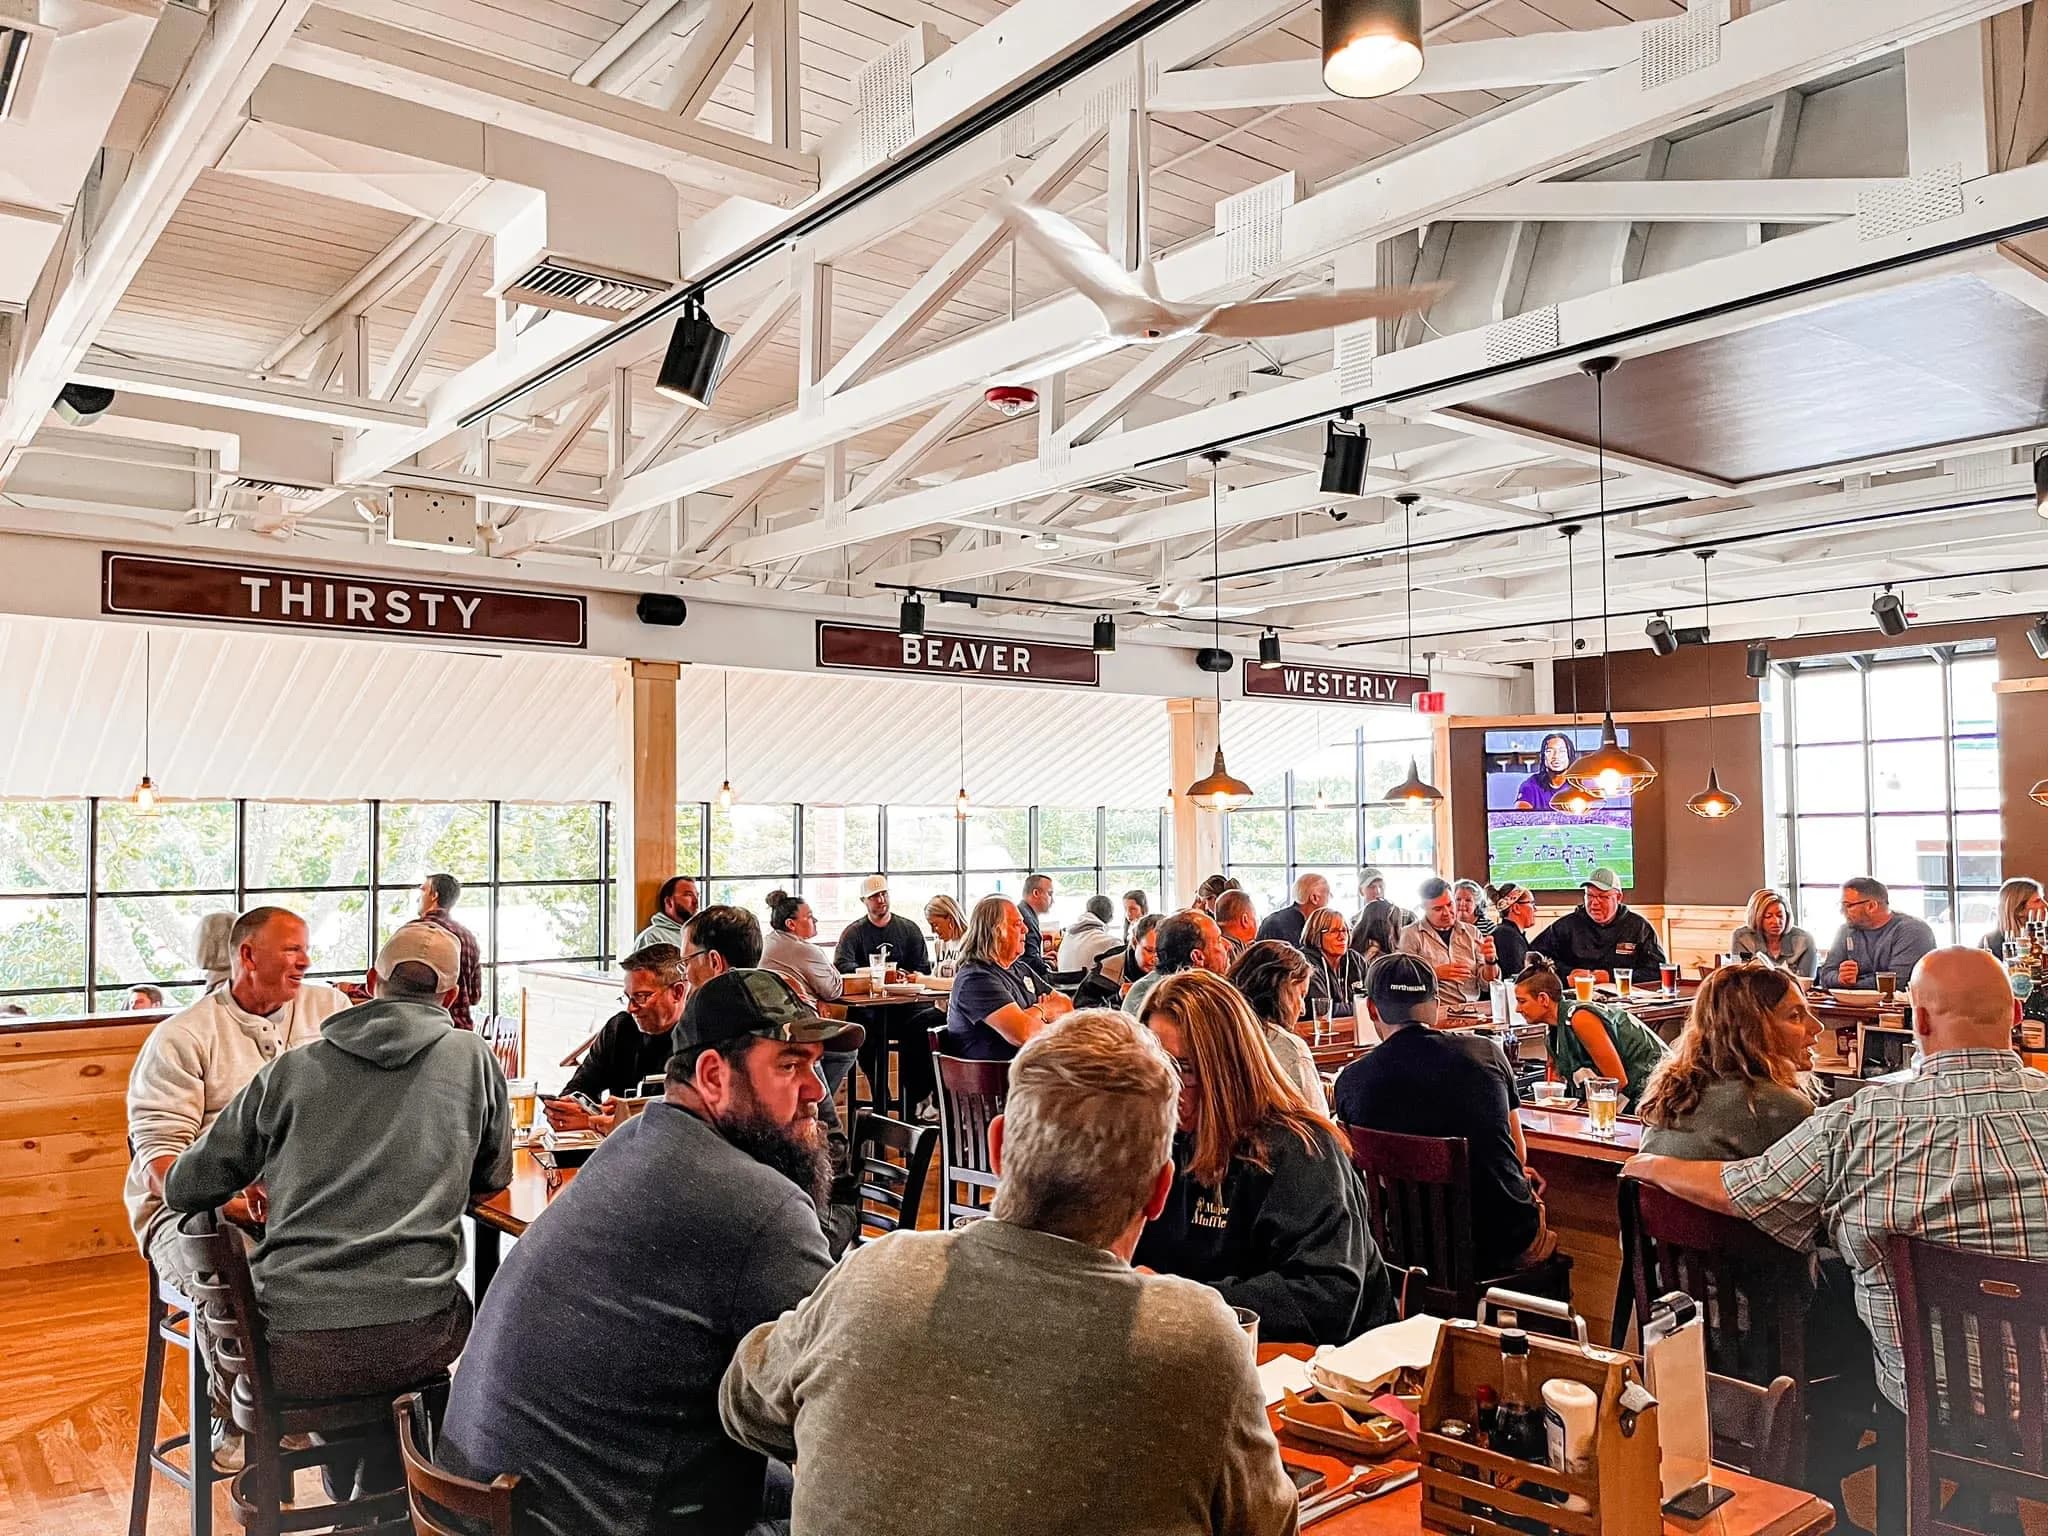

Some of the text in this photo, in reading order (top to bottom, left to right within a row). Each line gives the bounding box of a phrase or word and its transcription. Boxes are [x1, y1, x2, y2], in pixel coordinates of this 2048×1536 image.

[240, 576, 482, 629] THIRSTY
[903, 638, 1030, 673] BEAVER
[1284, 669, 1398, 700] WESTERLY
